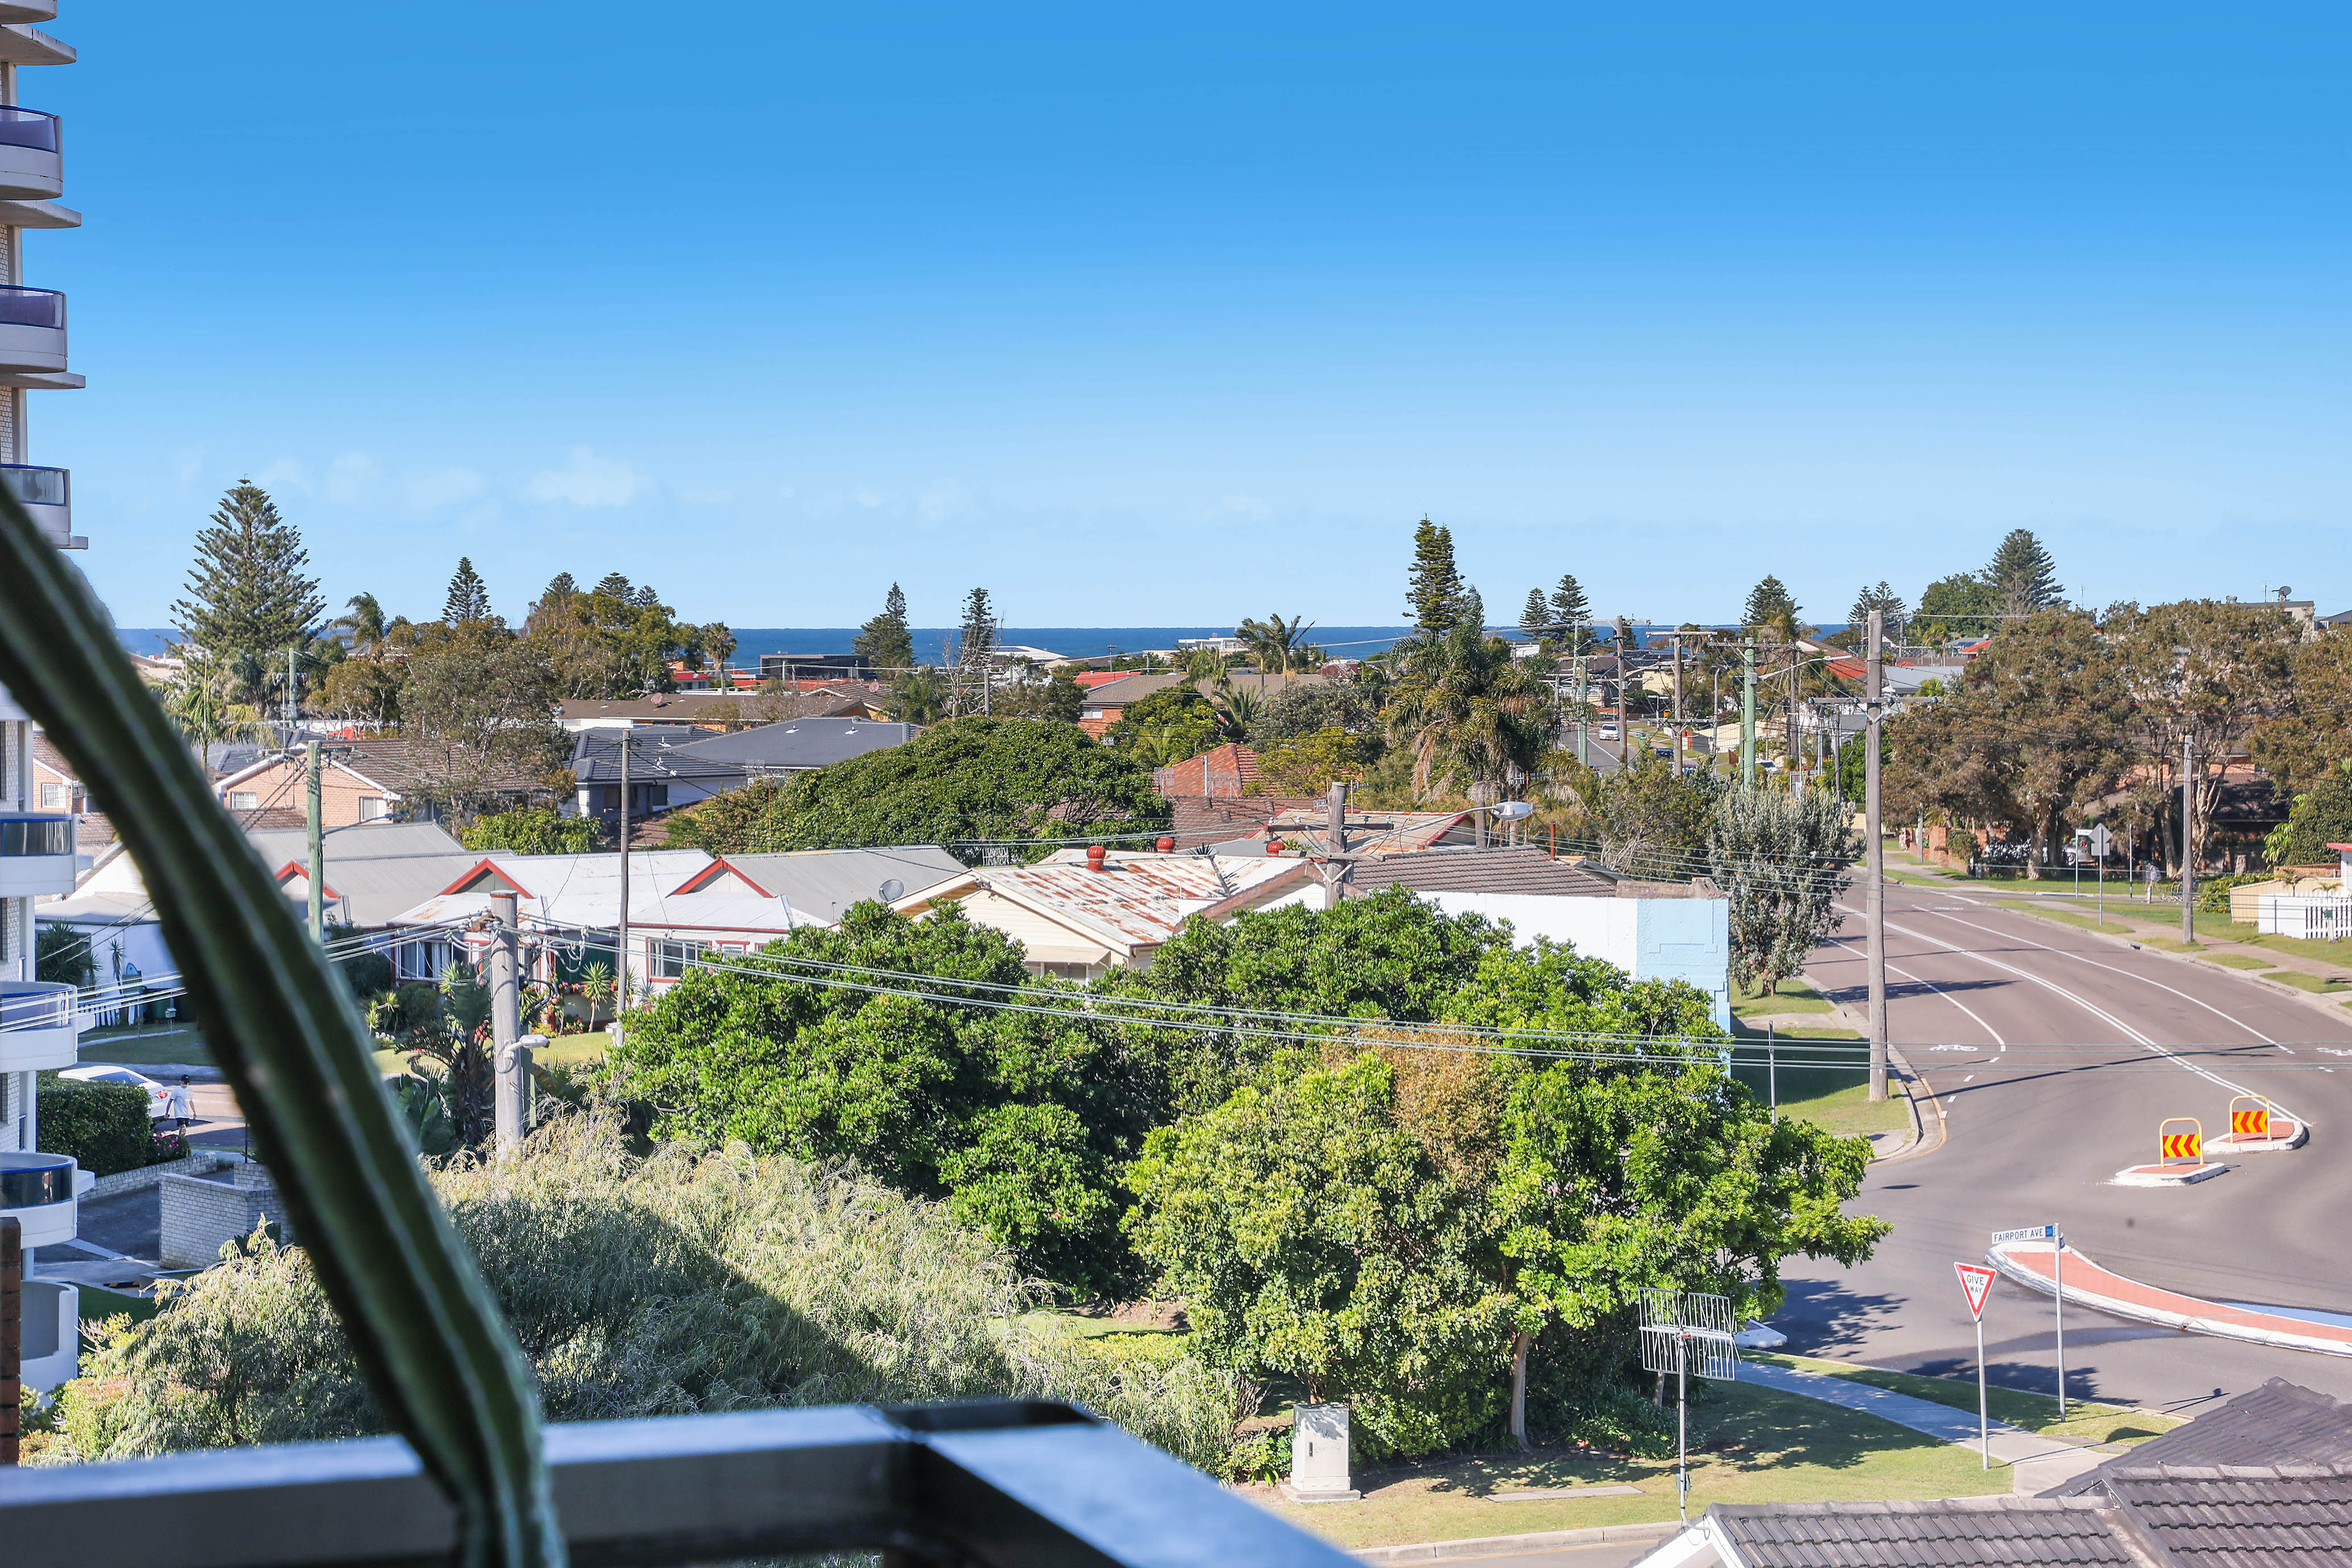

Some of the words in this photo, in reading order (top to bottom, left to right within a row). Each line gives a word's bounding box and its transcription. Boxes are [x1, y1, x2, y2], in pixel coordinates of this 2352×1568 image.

[1994, 1230, 2028, 1242] FAIRPORT
[2030, 1228, 2044, 1237] AVE
[1967, 1274, 1984, 1286] GIVE
